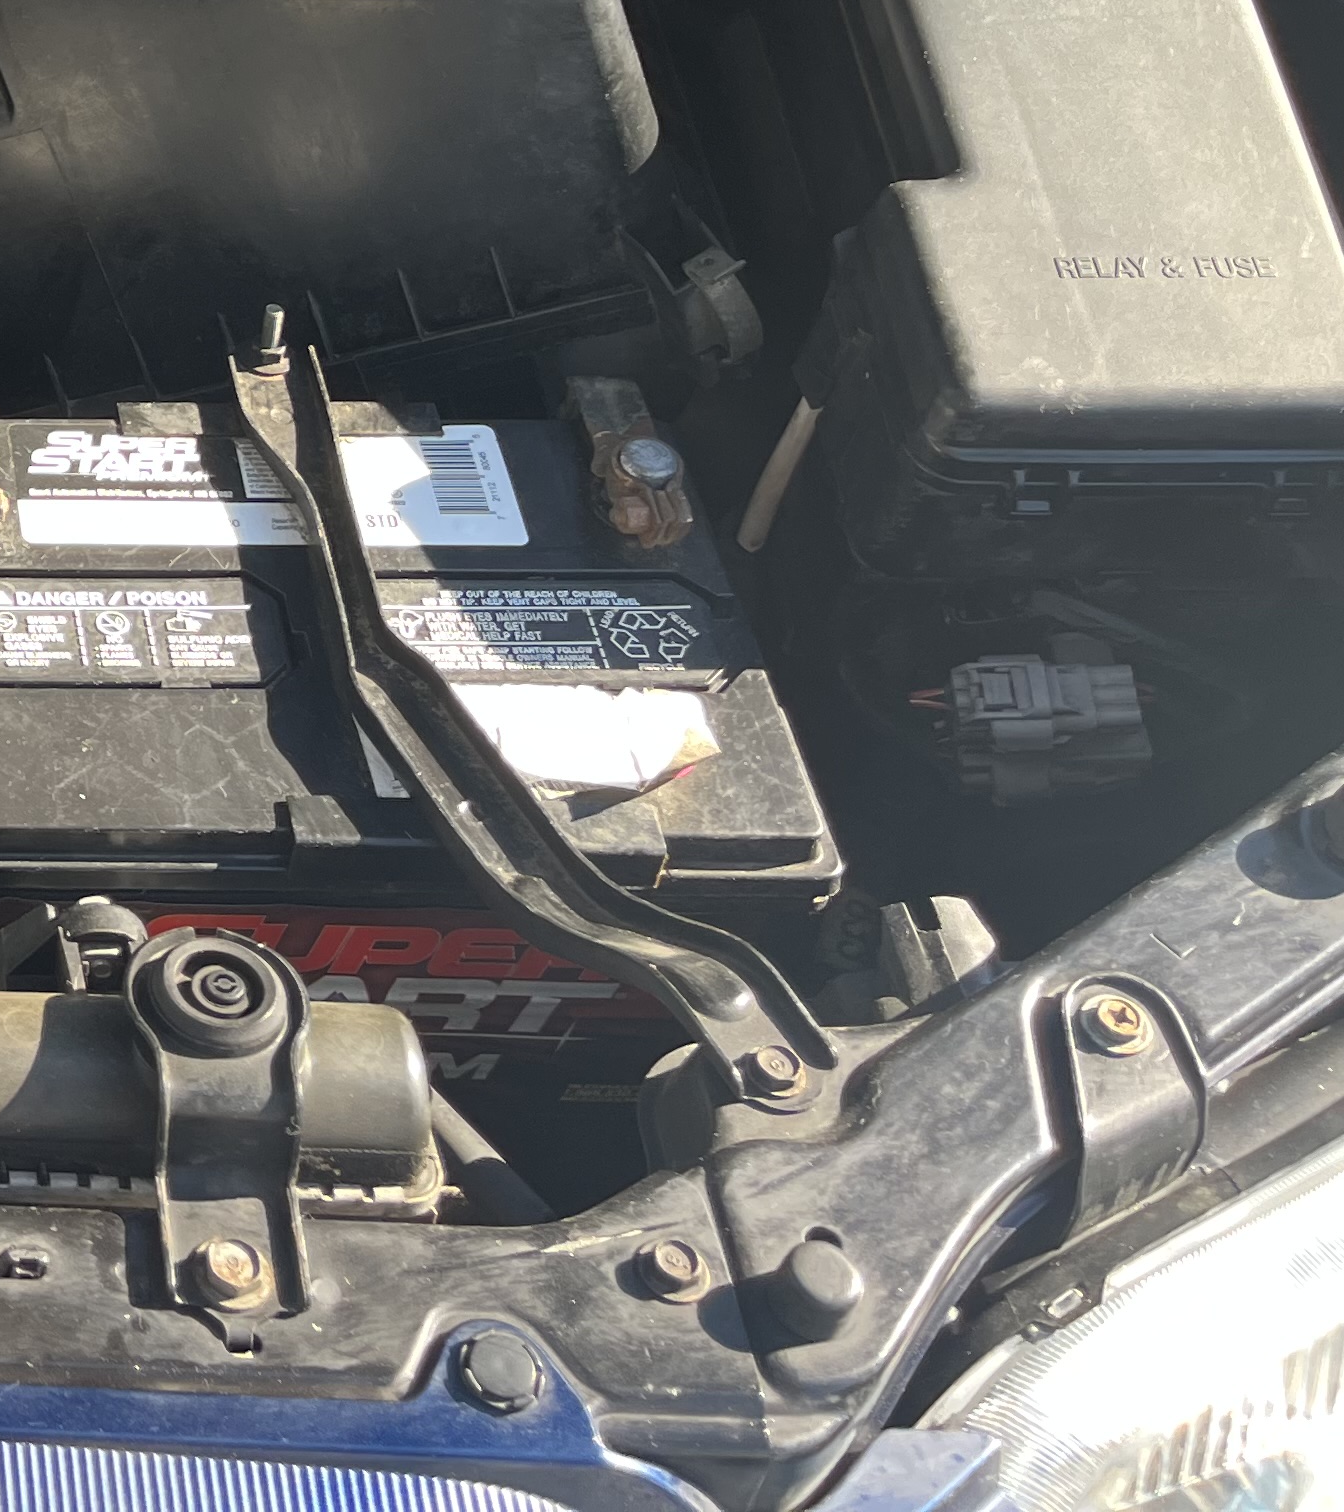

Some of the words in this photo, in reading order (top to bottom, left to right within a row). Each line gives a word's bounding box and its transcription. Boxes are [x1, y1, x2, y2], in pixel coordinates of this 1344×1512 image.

[1053, 255, 1149, 279] RELAY
[1161, 255, 1185, 279] &
[1192, 255, 1279, 279] FUSE
[15, 591, 105, 606] DANGER
[127, 591, 208, 606] POISON
[466, 590, 485, 598] OUT
[487, 590, 500, 598] OF
[556, 590, 570, 598] OF
[590, 598, 611, 606] AND
[464, 612, 493, 622] EYES
[495, 611, 570, 622] IMMEDIATELY
[598, 610, 616, 629] LEAD
[503, 621, 526, 631] GET
[666, 611, 700, 638] RETURN
[482, 631, 511, 641] HELP
[513, 631, 543, 641] FAST
